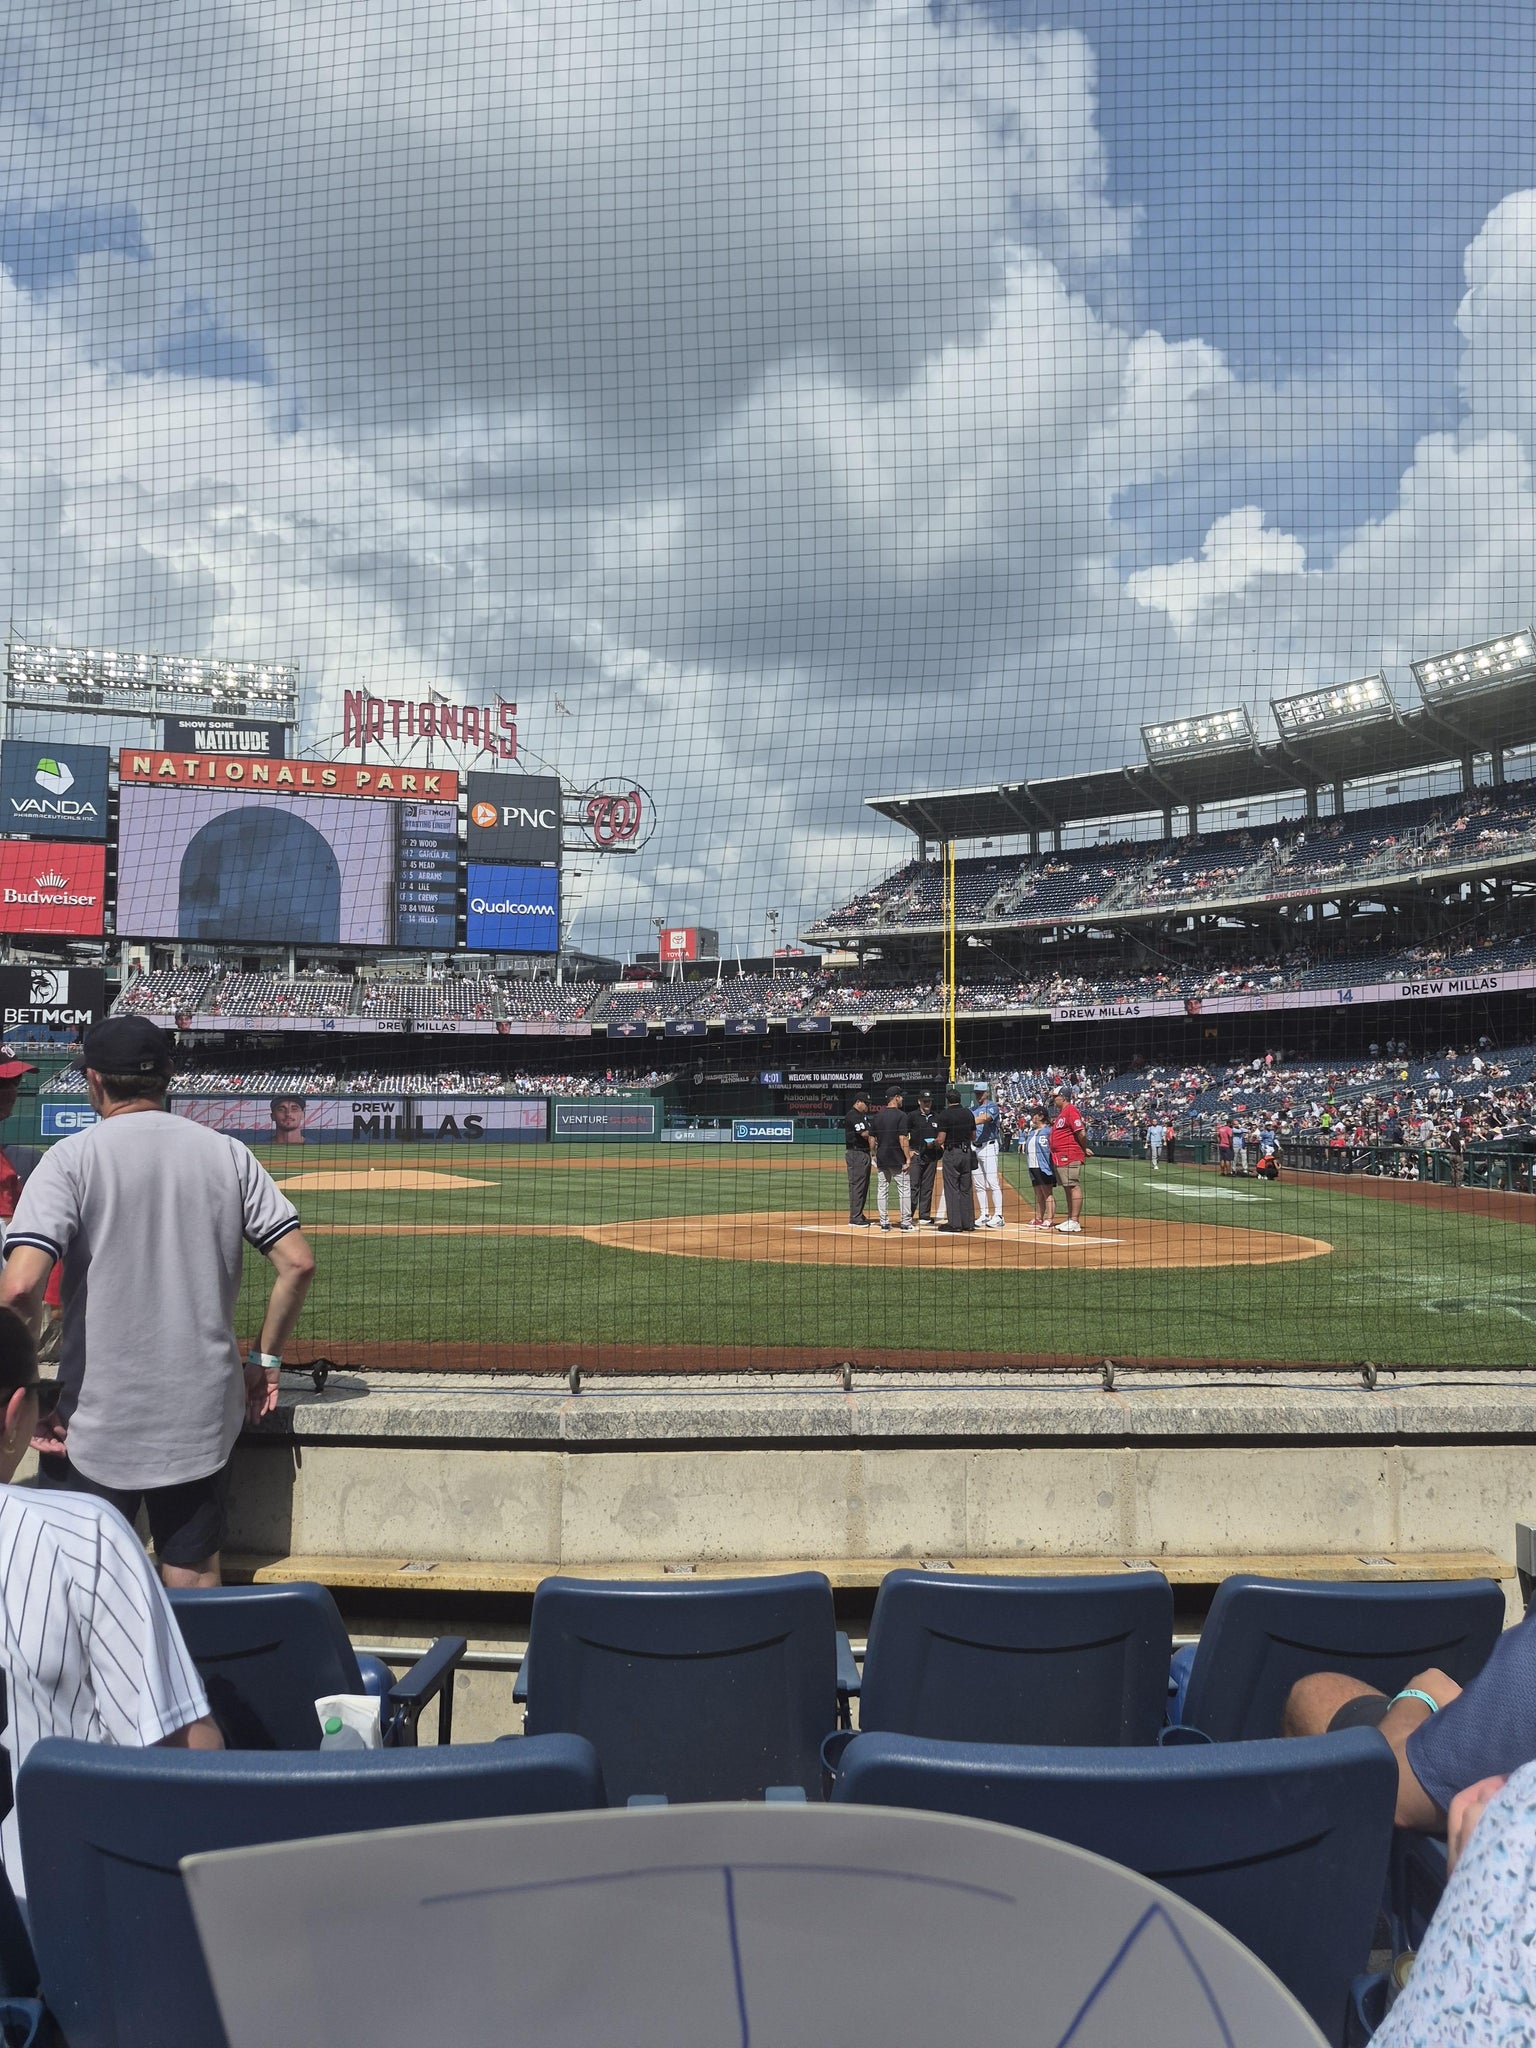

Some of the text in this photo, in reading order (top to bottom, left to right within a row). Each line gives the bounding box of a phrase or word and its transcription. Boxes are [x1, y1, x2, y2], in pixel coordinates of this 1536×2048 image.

[344, 689, 517, 760] NATIONALS
[195, 730, 270, 751] NATITUDE
[133, 755, 441, 793] NATIONALS PARK
[10, 798, 98, 815] VANDA
[418, 808, 451, 817] BETMGM
[501, 806, 556, 829] PNC
[418, 839, 438, 848] WOOD
[418, 860, 436, 870] MEAD
[418, 882, 430, 891] LILE
[3, 888, 96, 905] Budweiser
[418, 893, 438, 902] CREWS
[417, 904, 435, 913] VIVAS
[470, 897, 555, 916] Qualcomm
[1402, 978, 1498, 996] DREW MILLAS
[1336, 989, 1354, 1003] 14
[4, 1008, 92, 1025] BETMGM
[1060, 1006, 1141, 1019] DREW MILLAS
[320, 1019, 336, 1030] 14
[377, 1021, 457, 1031] DREW MILLAS
[763, 1073, 779, 1083] 4:01
[788, 1073, 812, 1081] WELCOME
[820, 1073, 848, 1081] NATIONALS
[849, 1073, 864, 1081] PARK
[884, 1071, 921, 1079] WASHINGTON
[783, 1093, 840, 1101] Nationals Park
[352, 1103, 395, 1113] DREW
[789, 1102, 833, 1110] powered by
[522, 1109, 543, 1126] 14
[562, 1115, 608, 1124] VENTURE
[353, 1114, 485, 1140] MILLAS
[749, 1127, 791, 1136] DABOS
[854, 1122, 866, 1131] 33
